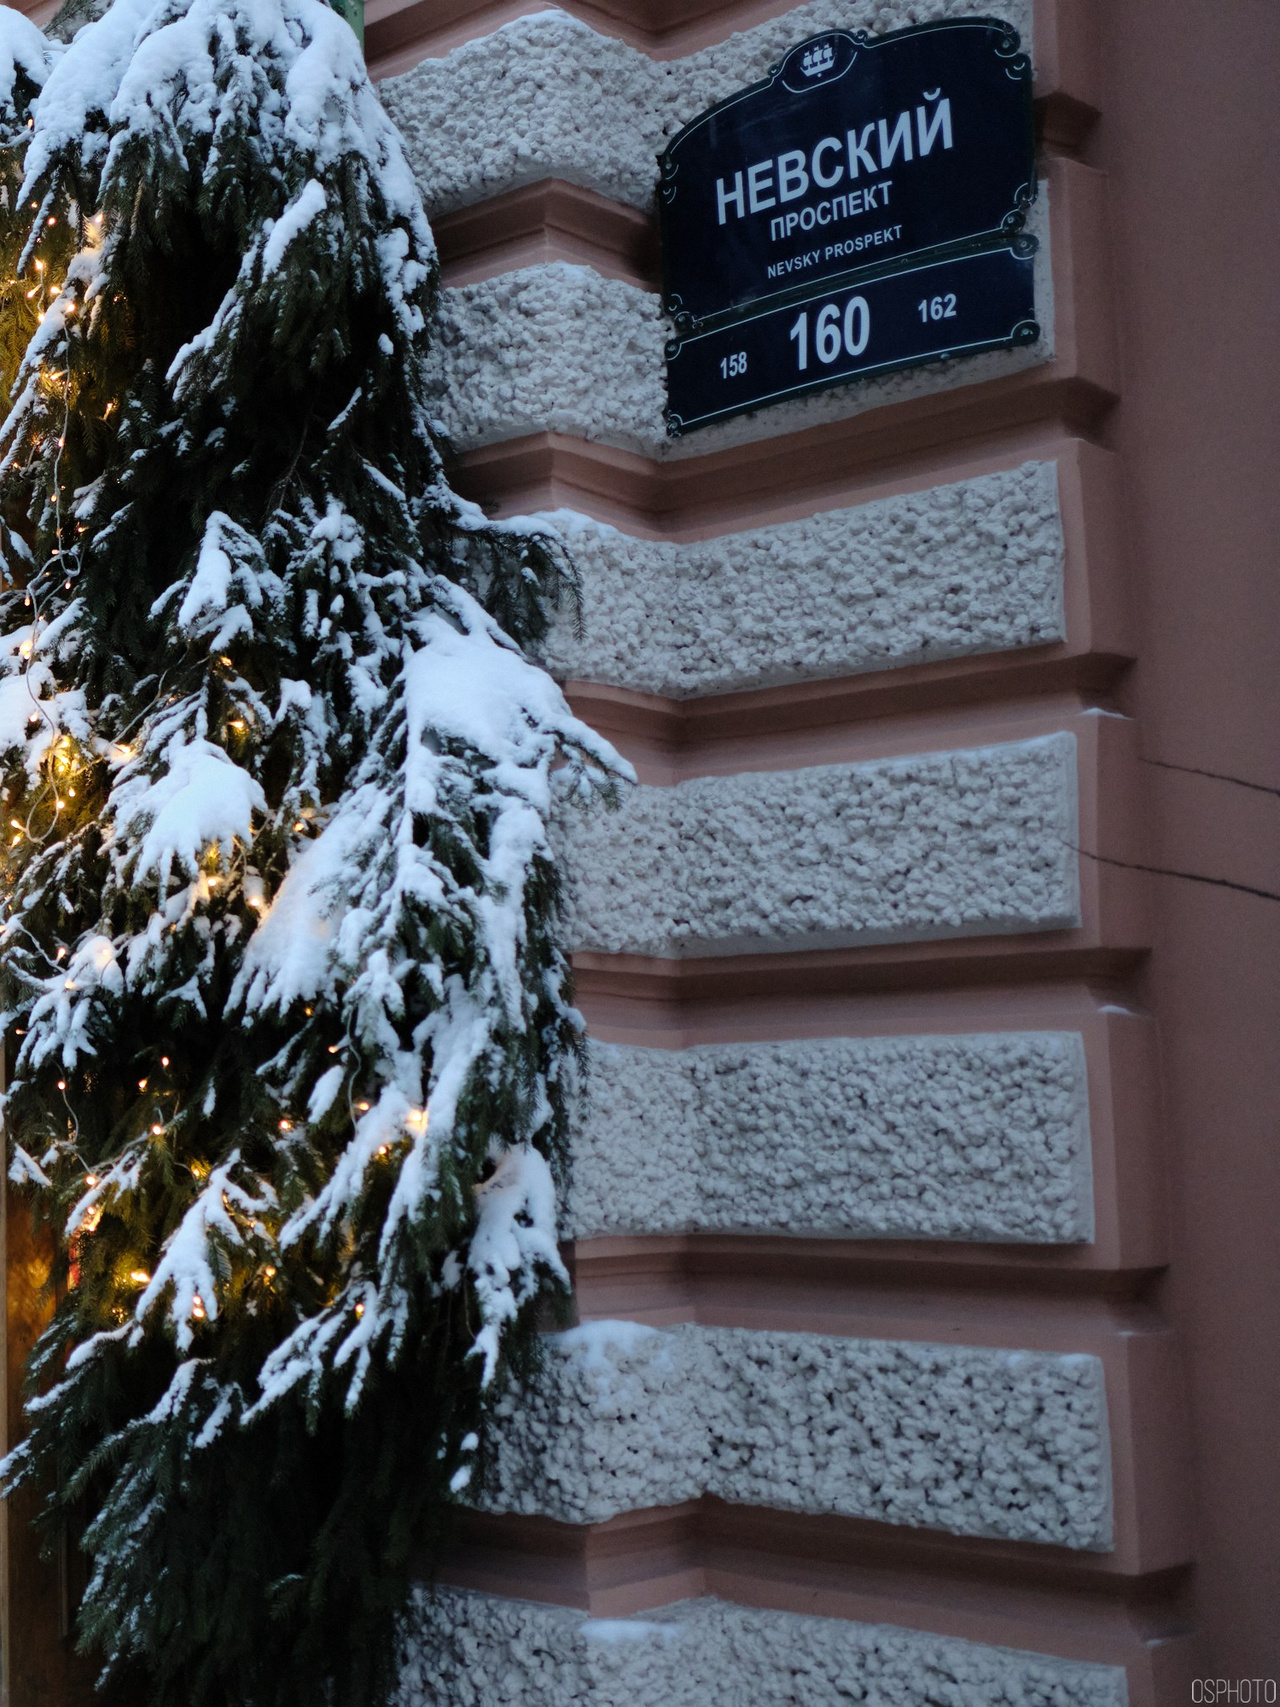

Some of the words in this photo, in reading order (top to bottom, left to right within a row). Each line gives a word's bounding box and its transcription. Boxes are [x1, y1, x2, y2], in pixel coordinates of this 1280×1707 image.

[715, 87, 954, 226] НЕВСКИЙ
[769, 180, 894, 242] ПРОСПЕКТ
[767, 250, 821, 280] NEVSKY
[824, 225, 903, 263] PROSPEKT
[719, 351, 748, 380] 158
[789, 296, 871, 371] 160
[917, 293, 957, 324] 162
